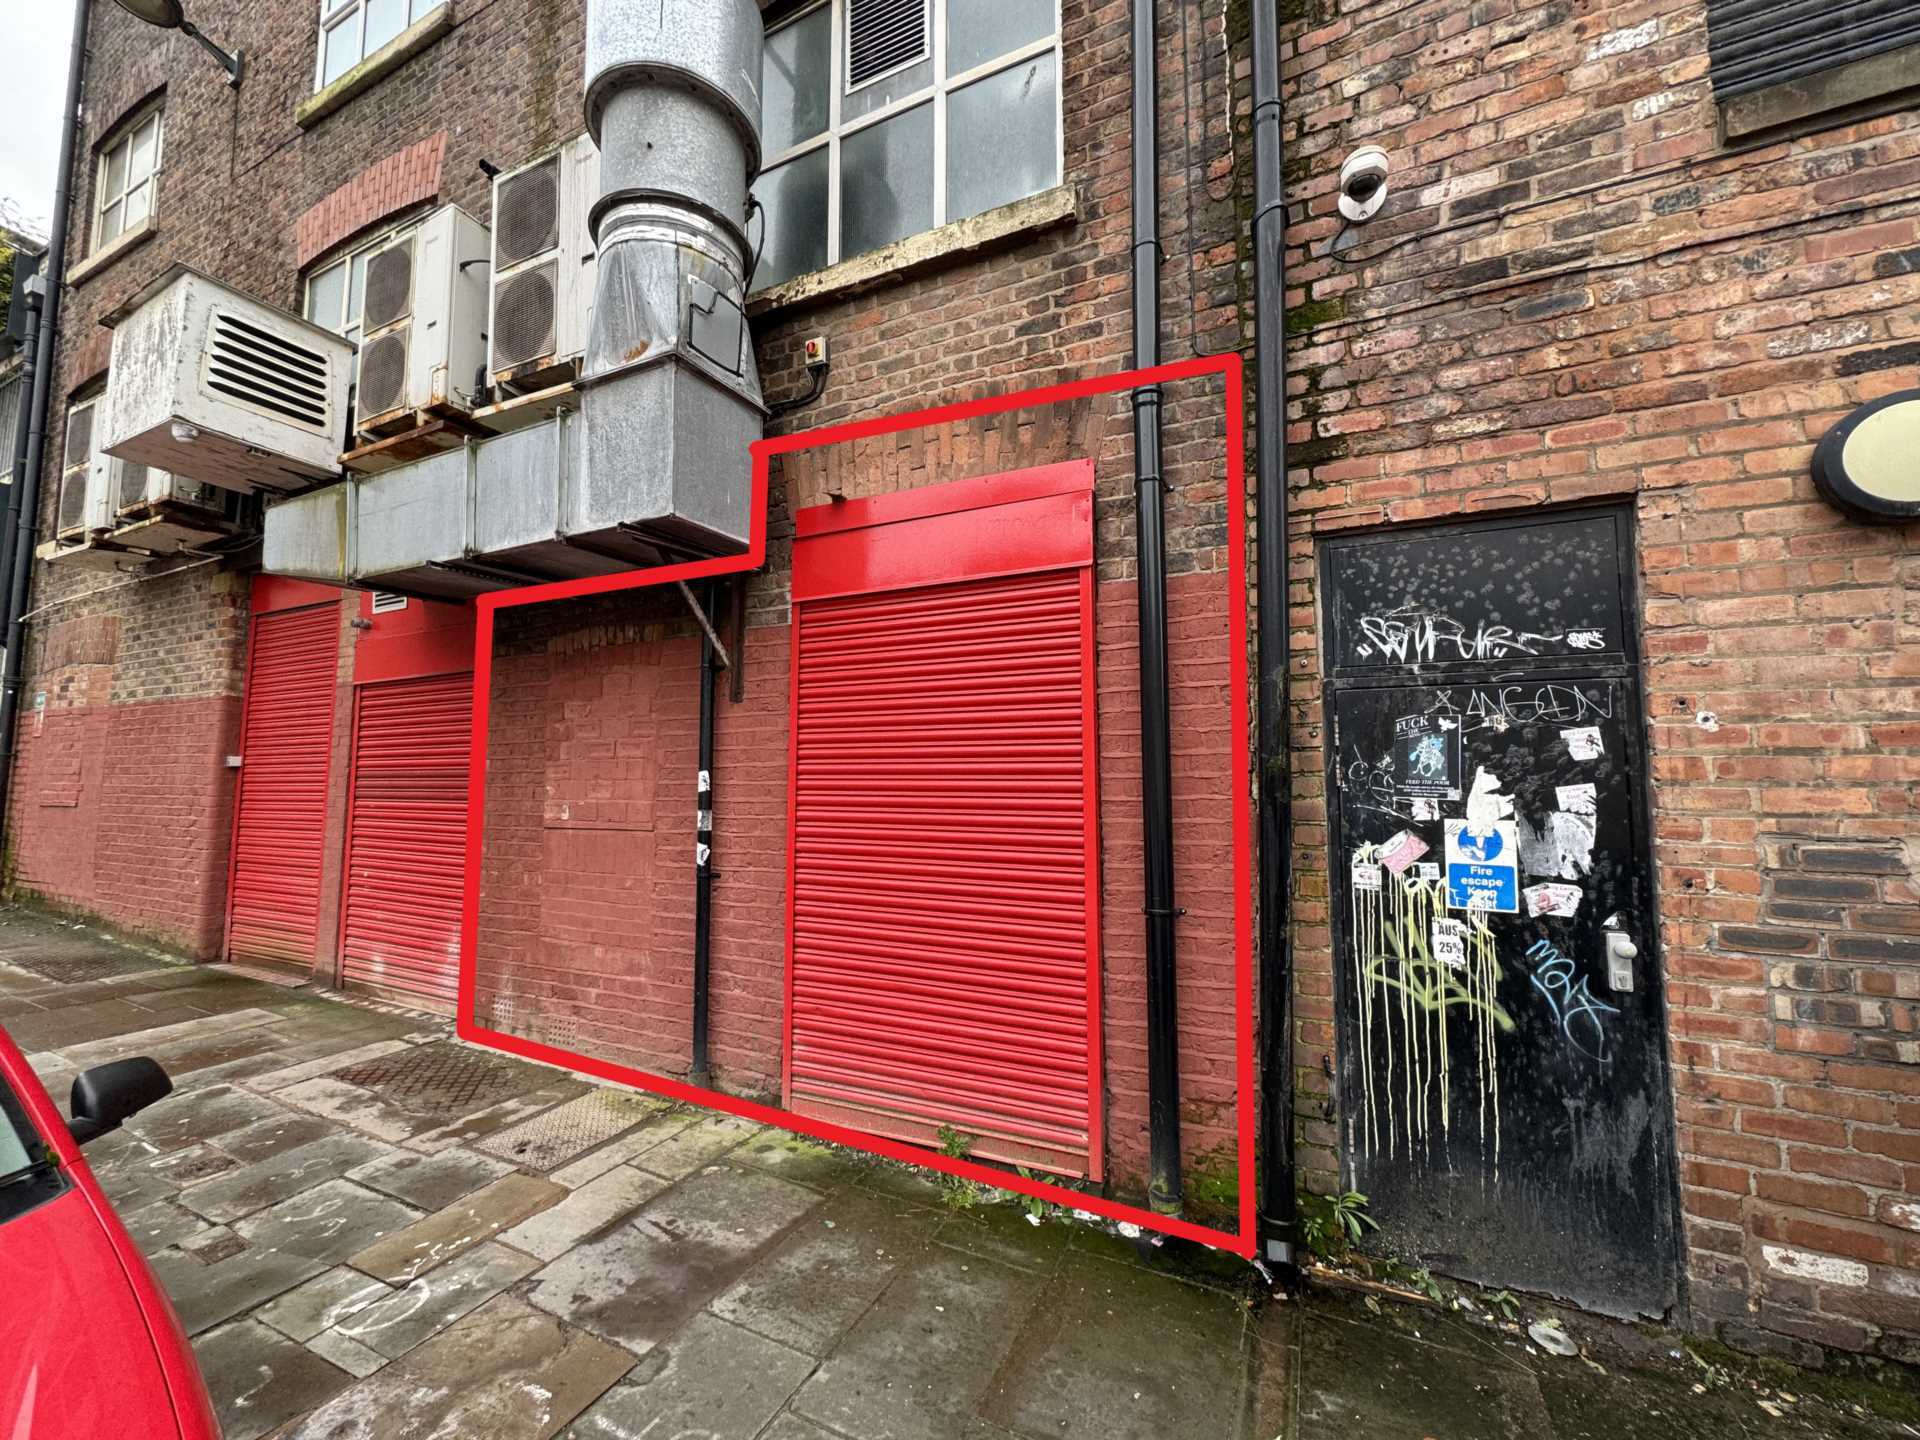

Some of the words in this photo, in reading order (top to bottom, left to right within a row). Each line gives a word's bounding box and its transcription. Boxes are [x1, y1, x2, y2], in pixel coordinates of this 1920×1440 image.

[1396, 716, 1429, 732] FUCK
[1470, 866, 1493, 876] Fire
[1460, 877, 1504, 888] escape
[1438, 924, 1459, 937] AUS
[1439, 942, 1462, 955] 25%
